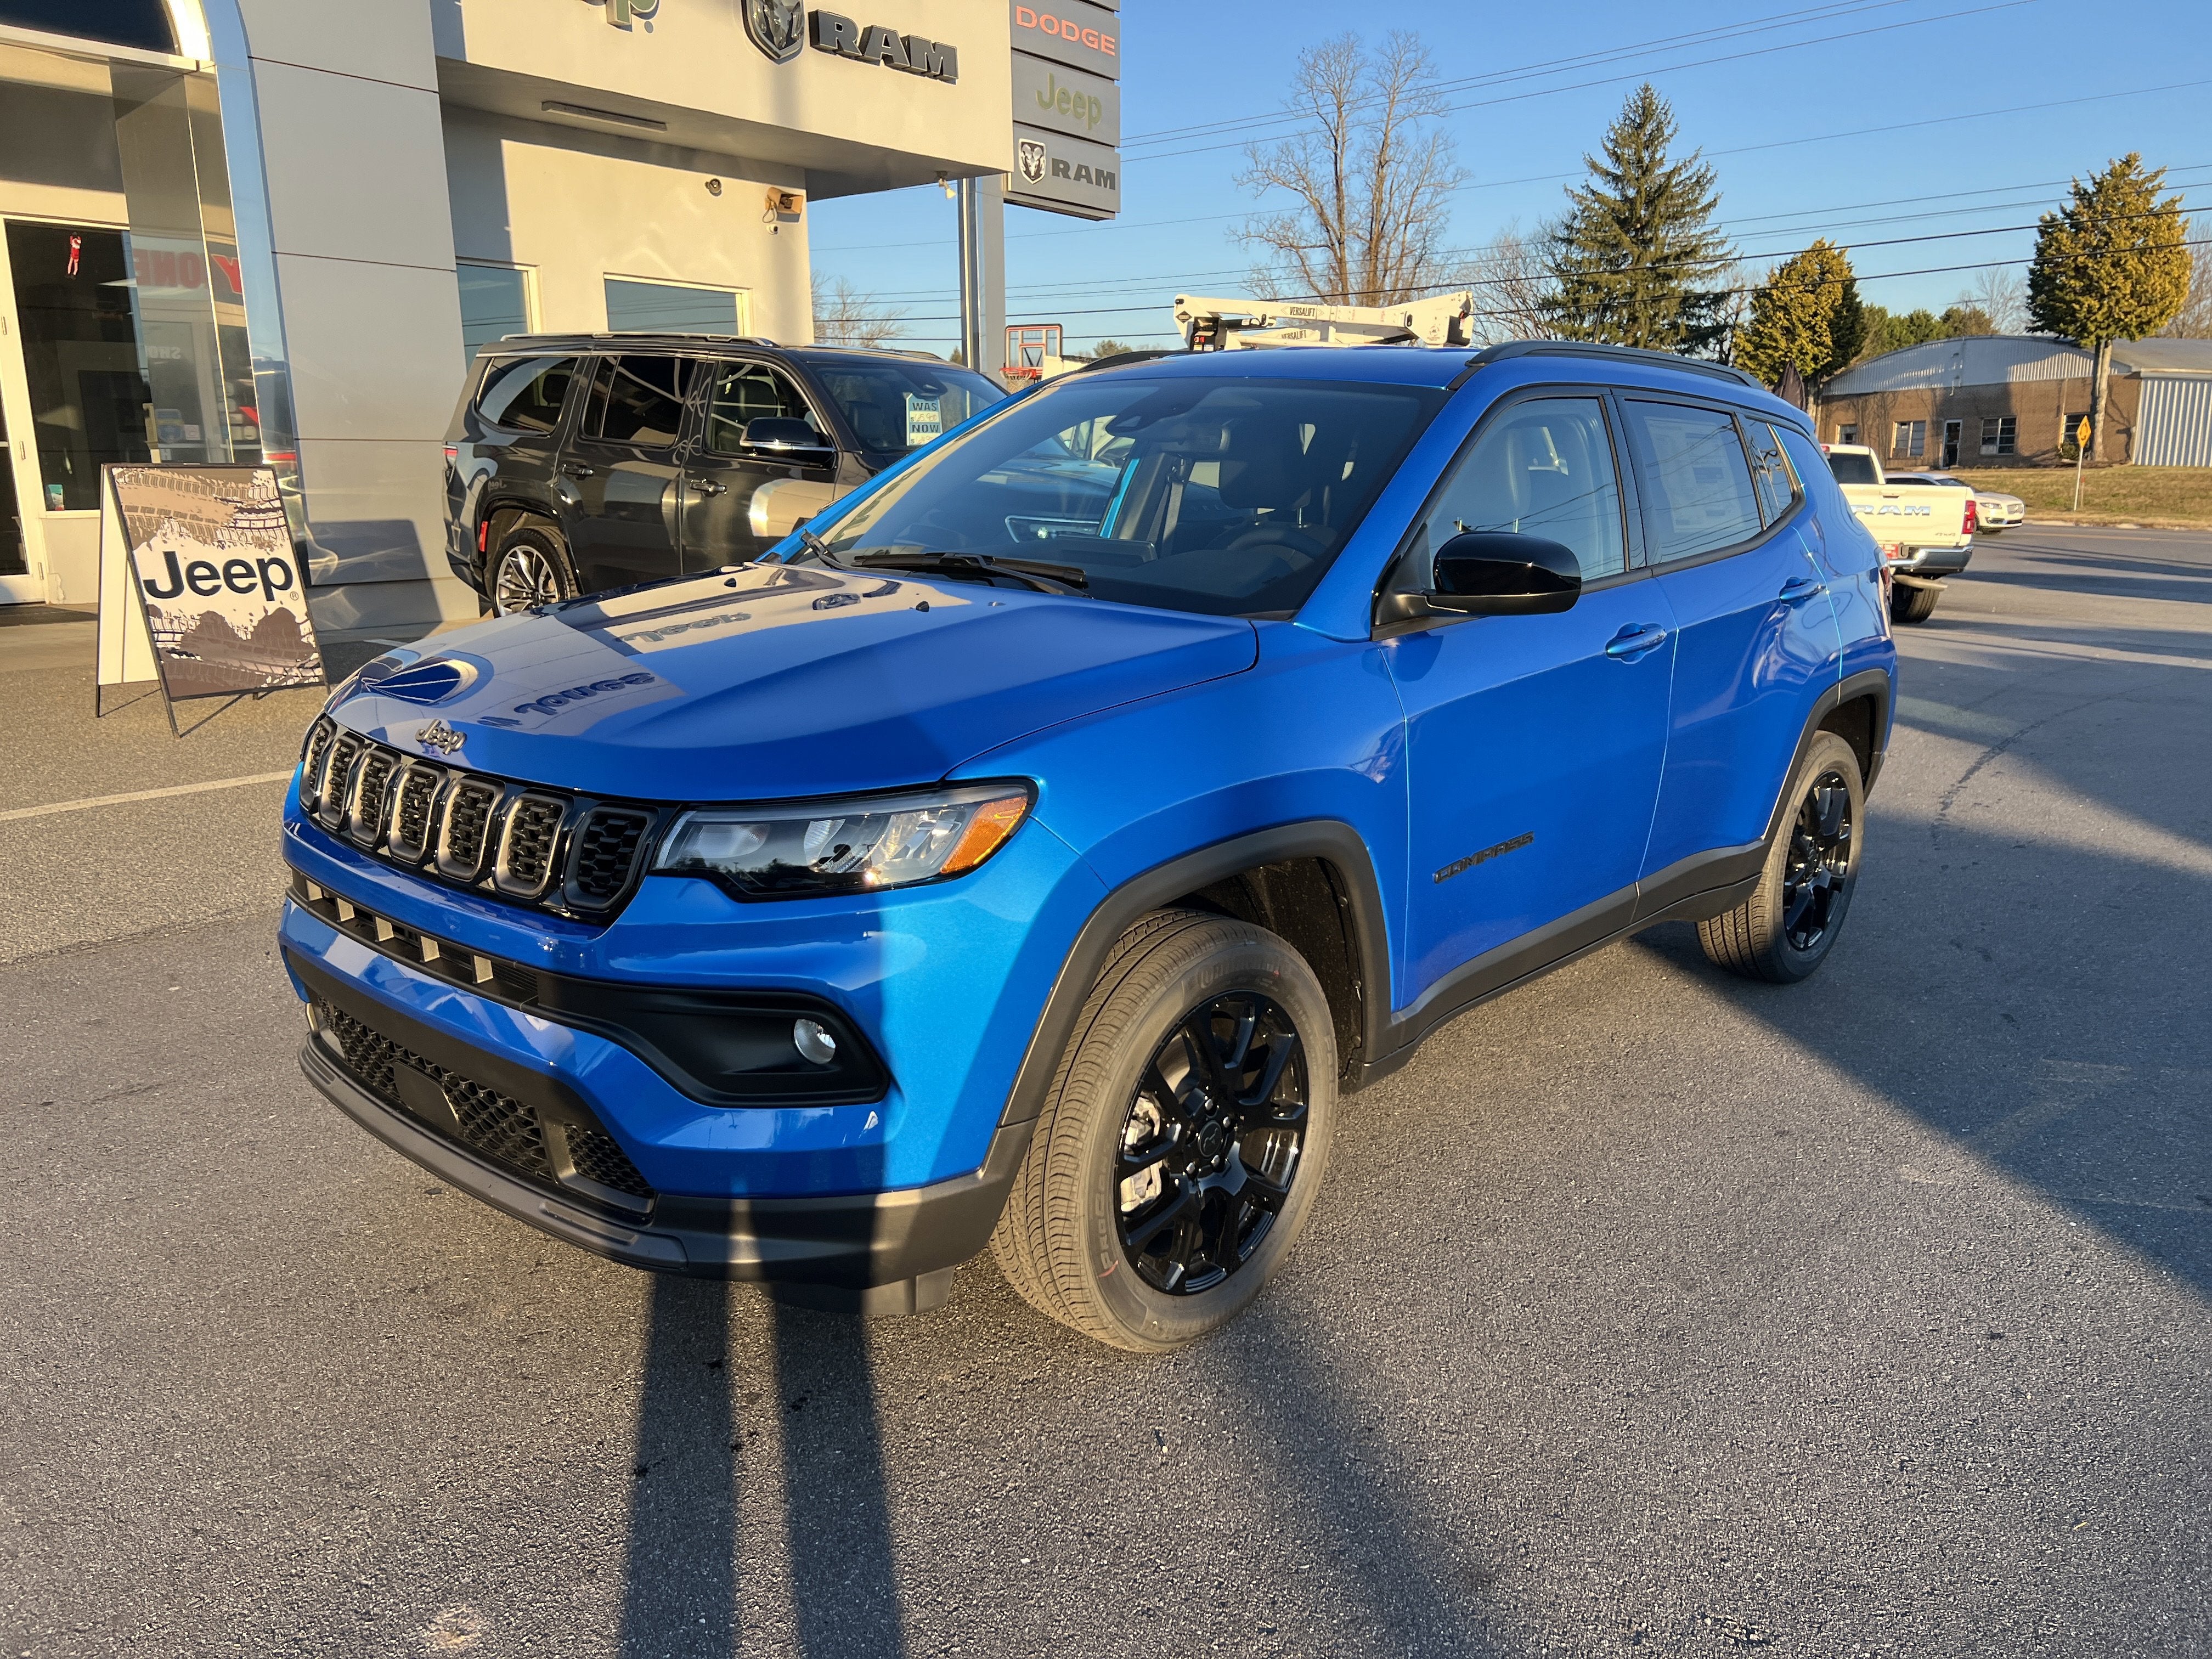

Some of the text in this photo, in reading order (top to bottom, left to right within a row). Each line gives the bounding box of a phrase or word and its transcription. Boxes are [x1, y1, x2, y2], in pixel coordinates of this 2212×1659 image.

[808, 9, 958, 83] RAM
[1016, 5, 1115, 56] DODGE
[1036, 72, 1102, 130] Jeep
[1051, 158, 1115, 190] RAM
[1290, 306, 1316, 317] VERSALIFT
[1281, 330, 1307, 340] VERSALIFT
[912, 402, 936, 411] WAS
[912, 424, 939, 433] NOW
[1850, 505, 1931, 516] RAM
[143, 551, 293, 601] Jeep
[415, 719, 467, 755] Jeep
[1433, 830, 1534, 884] COMPASS
